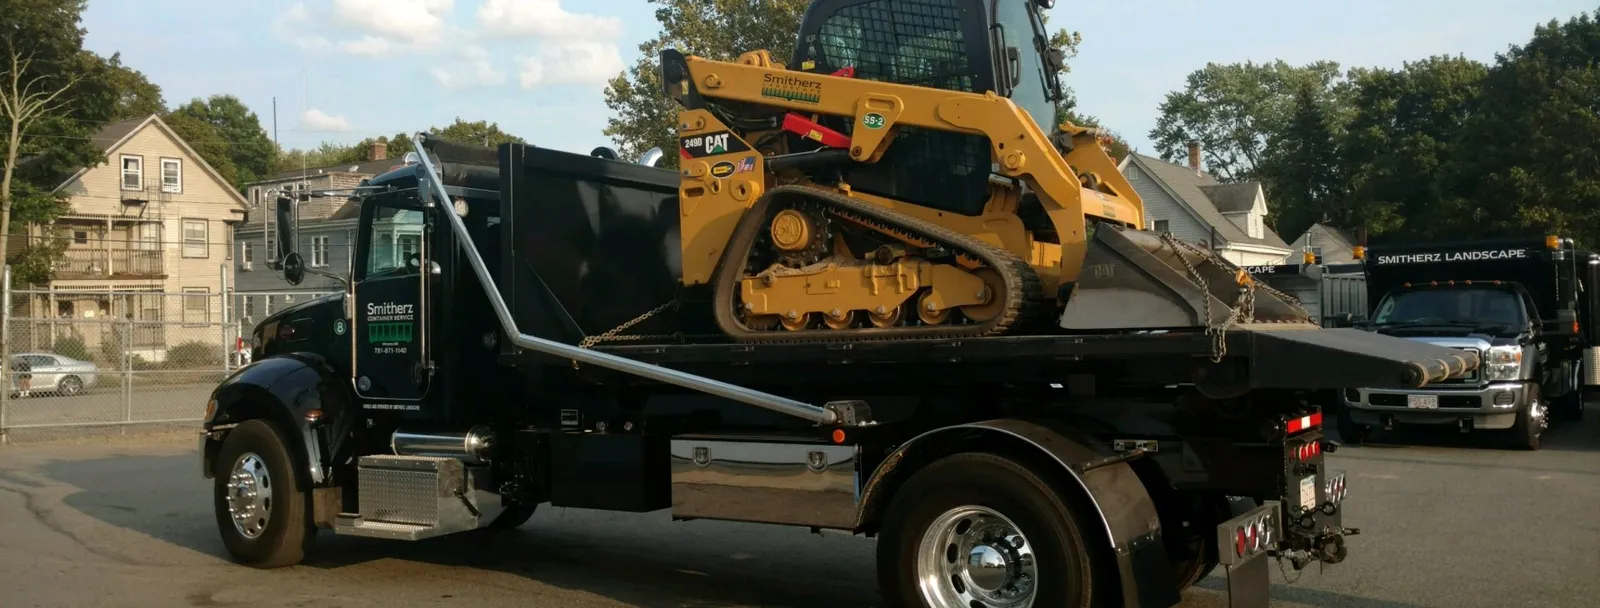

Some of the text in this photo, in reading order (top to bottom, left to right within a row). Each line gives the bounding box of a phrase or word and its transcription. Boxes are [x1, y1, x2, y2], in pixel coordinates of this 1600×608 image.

[763, 73, 822, 90] Smitherz
[864, 115, 884, 126] SS-2
[684, 133, 730, 154] 249D CAT
[1378, 249, 1526, 265] SMITHERZ LANDSCAPE
[367, 302, 413, 315] Smitherz
[336, 321, 344, 333] 8
